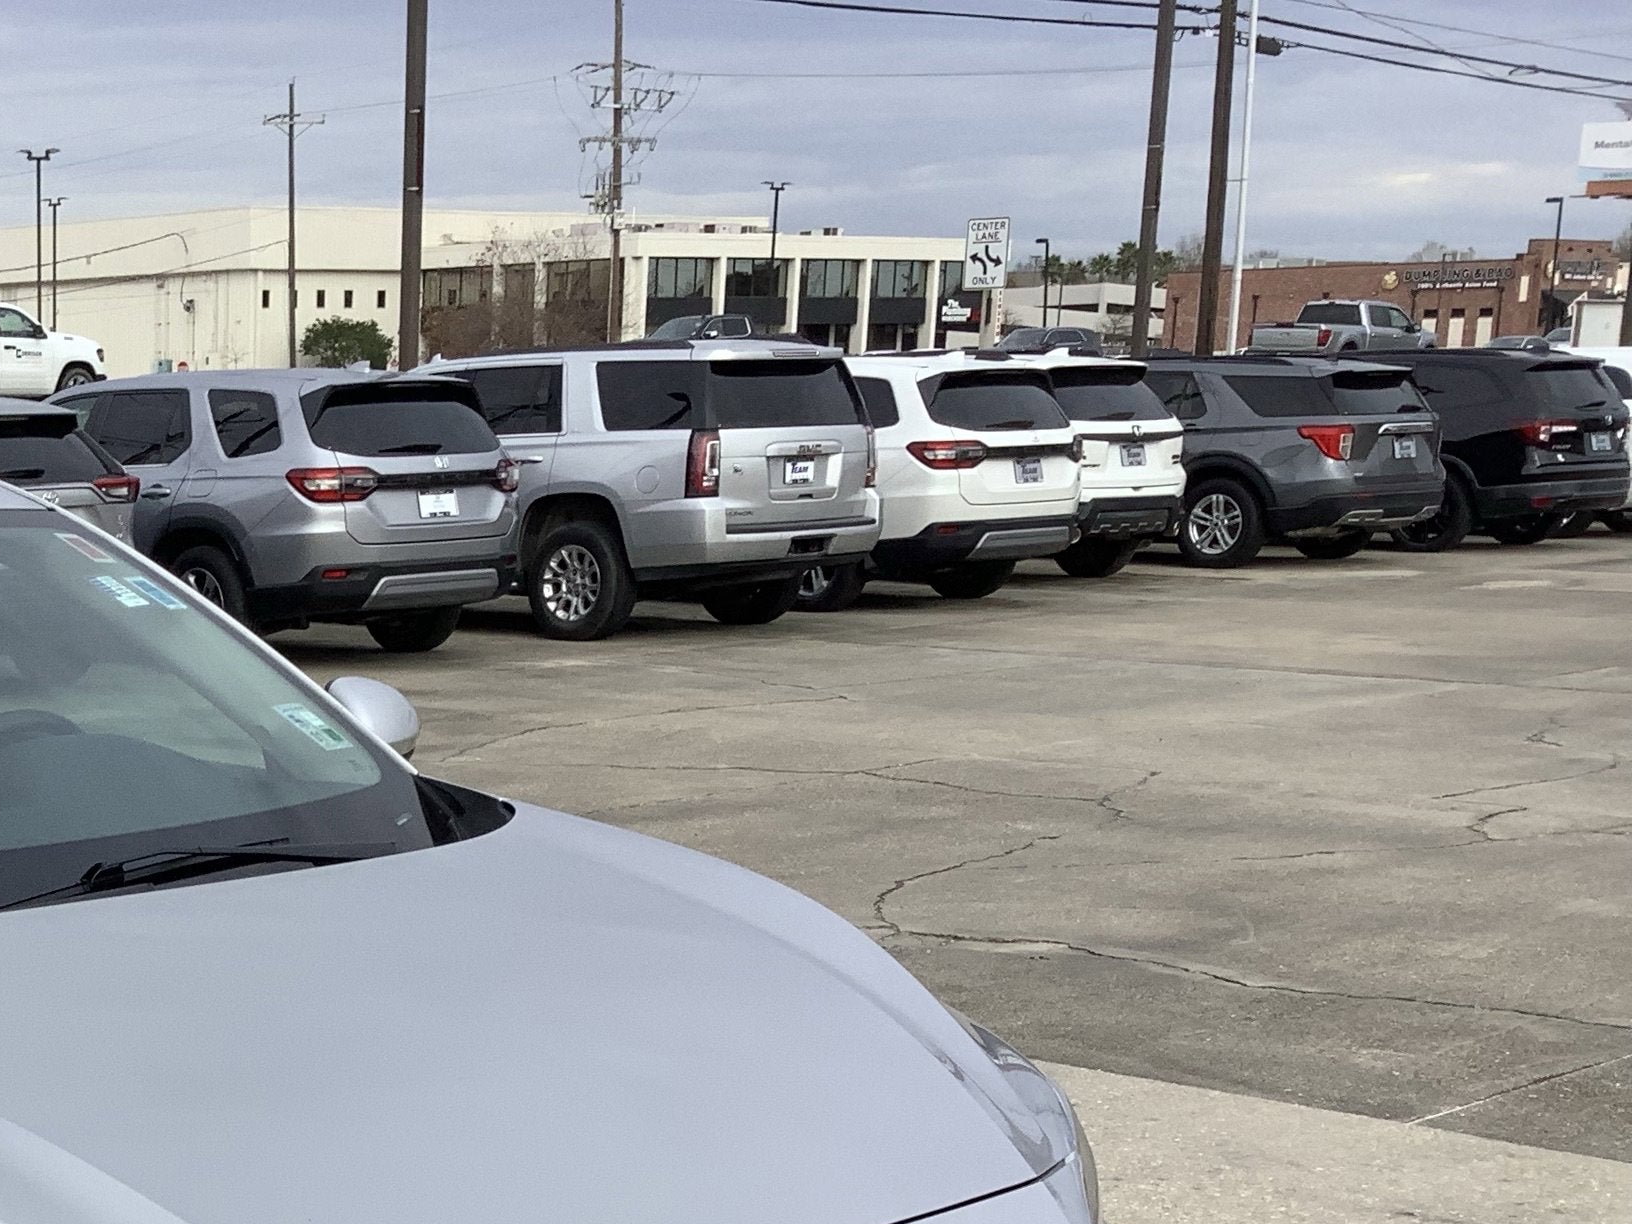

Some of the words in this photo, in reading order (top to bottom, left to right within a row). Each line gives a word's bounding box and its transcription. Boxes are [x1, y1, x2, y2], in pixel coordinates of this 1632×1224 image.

[970, 221, 1006, 232] CENTER
[975, 231, 1000, 241] LANE
[971, 276, 997, 286] ONLY
